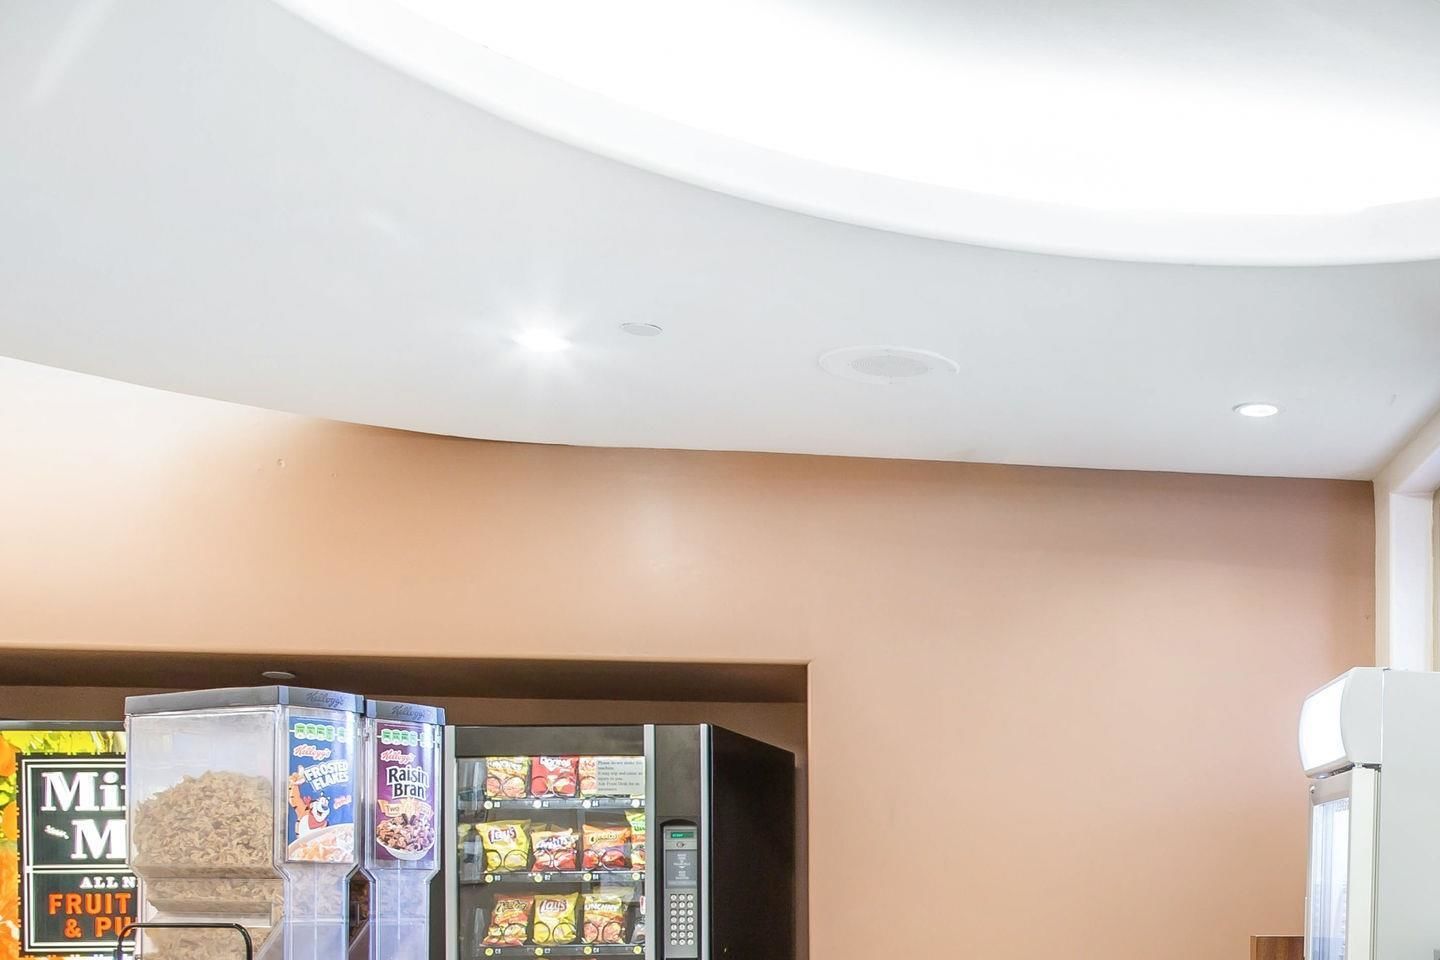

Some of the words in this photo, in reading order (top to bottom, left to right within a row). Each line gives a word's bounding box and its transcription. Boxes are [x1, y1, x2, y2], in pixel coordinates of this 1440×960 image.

[304, 761, 349, 781] FROSTED
[388, 766, 427, 786] Raisin
[40, 771, 126, 811] Mi
[394, 782, 424, 799] Bran
[80, 876, 119, 889] ALL
[48, 892, 132, 915] FRUIT
[63, 918, 82, 938] &
[95, 916, 137, 939] PU
